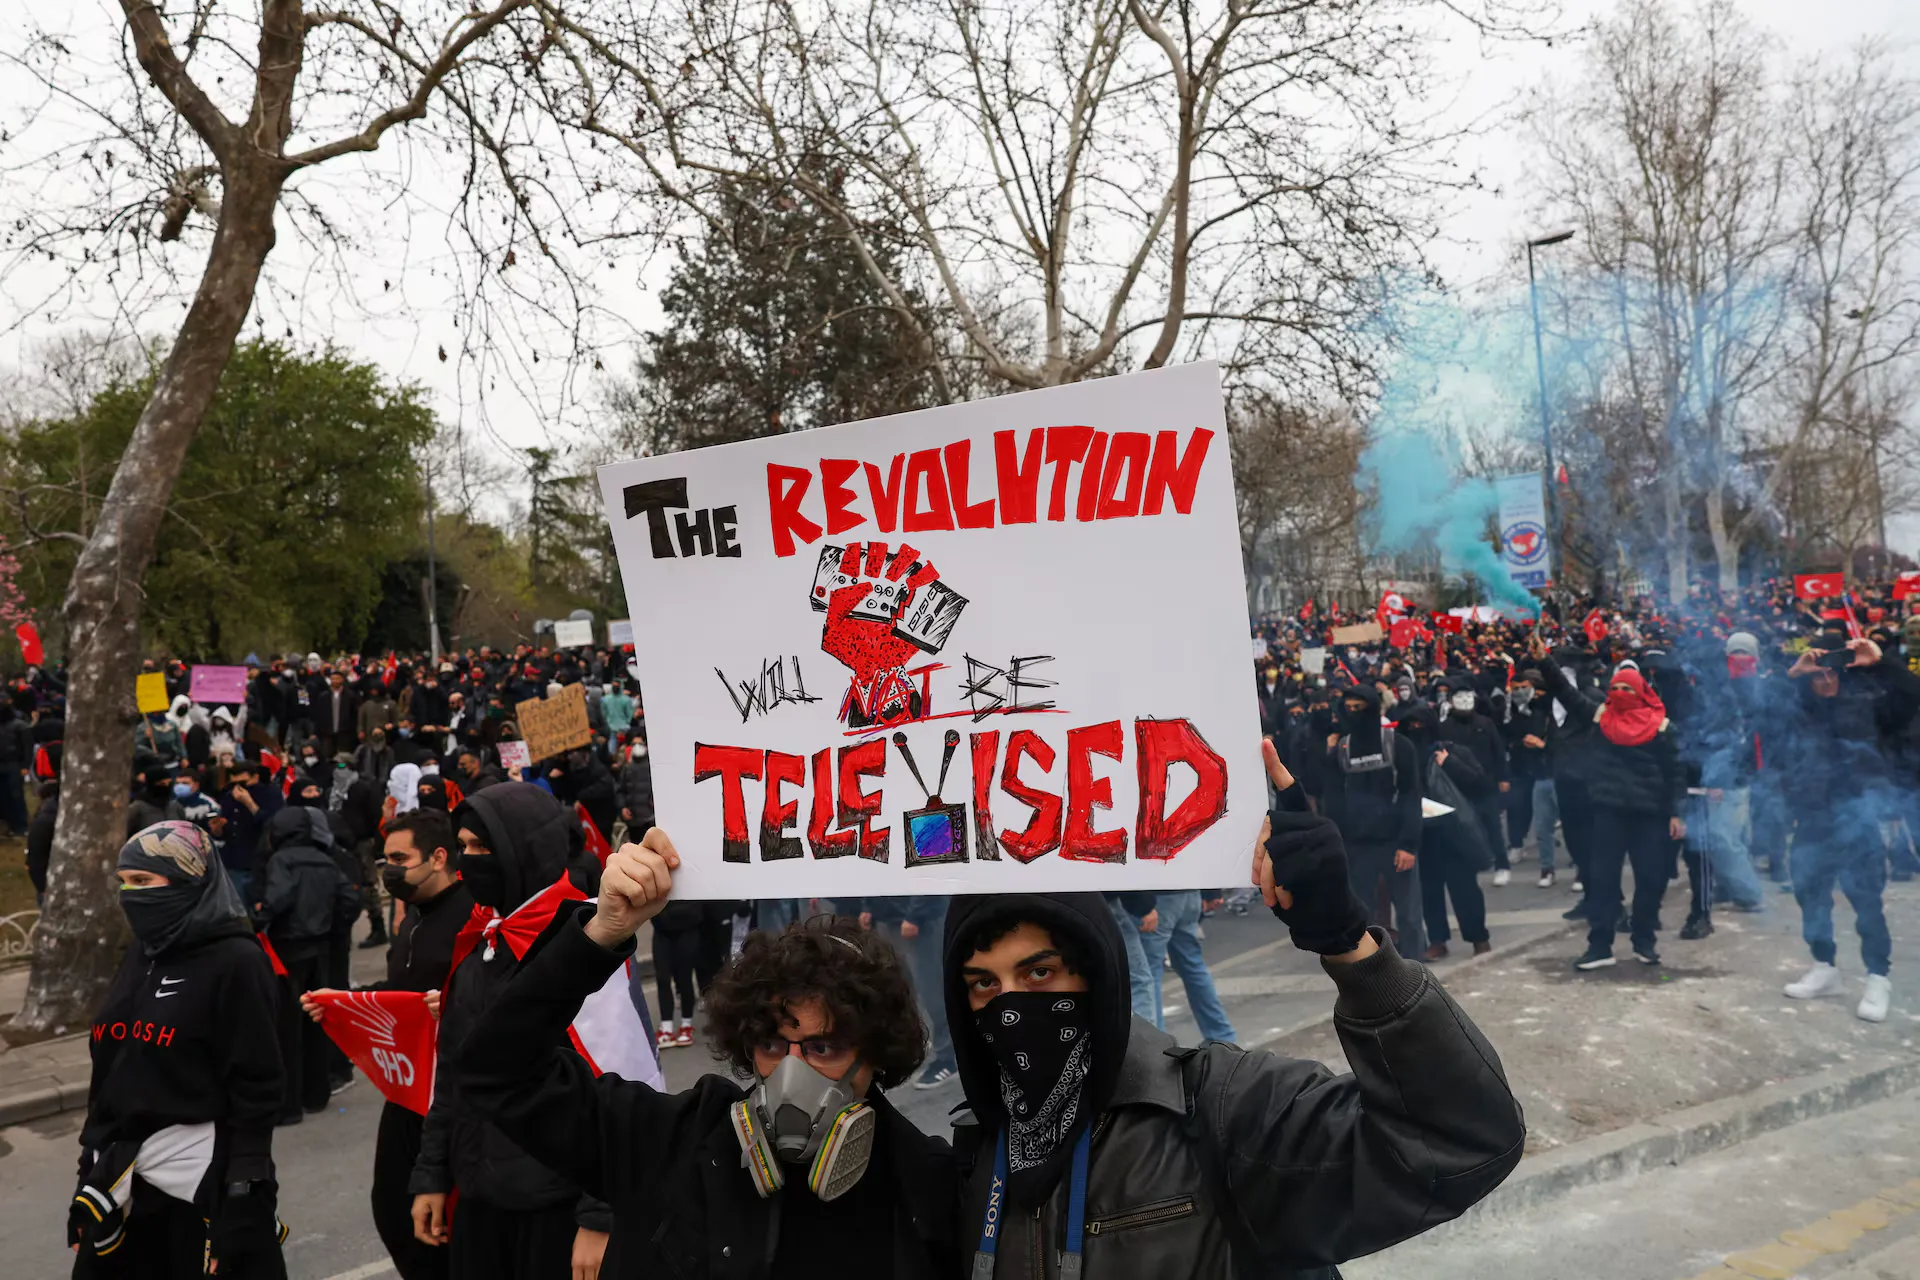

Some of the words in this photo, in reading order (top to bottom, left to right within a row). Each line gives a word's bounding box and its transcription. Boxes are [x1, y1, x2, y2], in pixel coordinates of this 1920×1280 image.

[623, 477, 742, 558] THE
[767, 426, 1215, 557] REVOLUTION
[714, 655, 822, 724] WILL
[836, 661, 952, 725] NOT
[959, 652, 1059, 723] BE
[694, 716, 1229, 868] TELEVISED
[985, 1175, 1003, 1238] SONY
